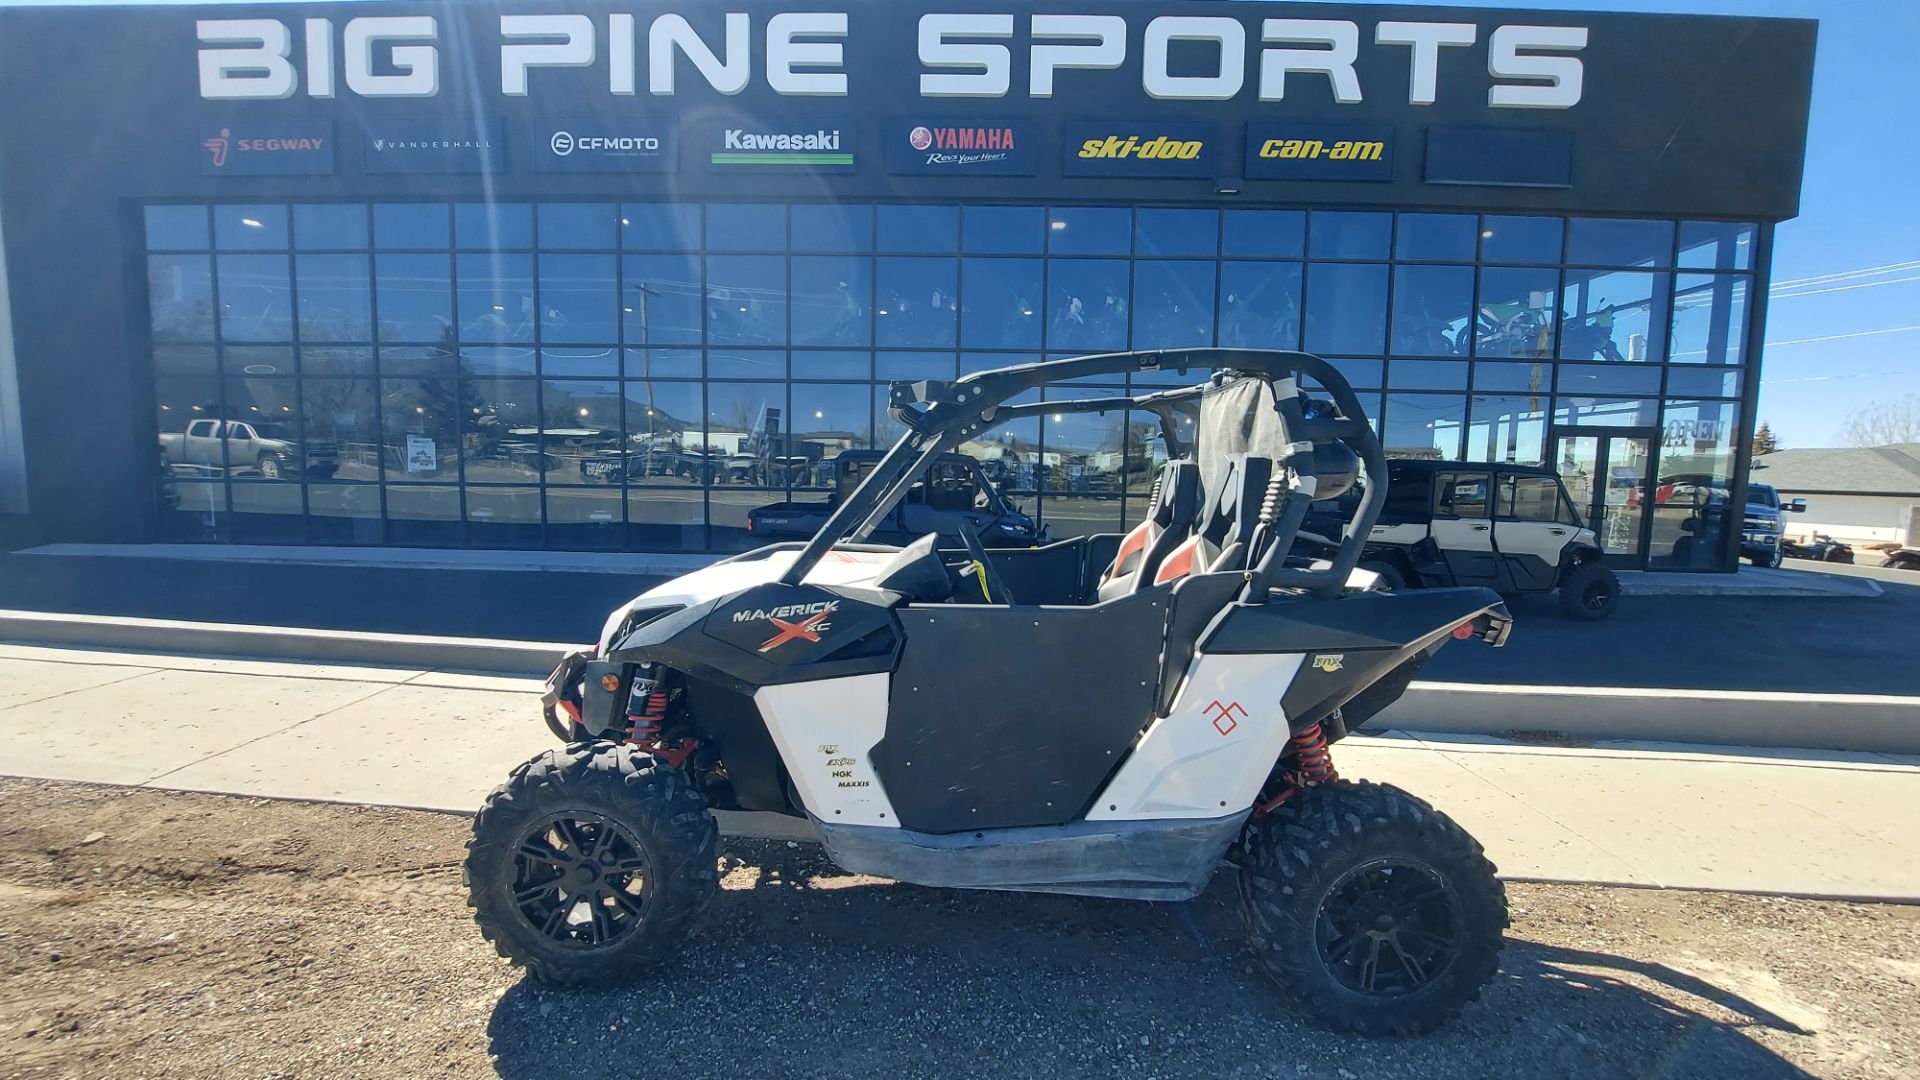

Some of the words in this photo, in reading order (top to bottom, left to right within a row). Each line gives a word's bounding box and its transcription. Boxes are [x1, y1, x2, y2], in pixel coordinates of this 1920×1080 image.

[197, 16, 439, 98] BIG
[501, 12, 849, 96] PINE
[918, 14, 1589, 108] SPORTS
[238, 138, 323, 151] SEGWAY
[388, 141, 492, 149] VANDERHALL
[578, 137, 659, 150] CFMOTO
[725, 130, 840, 150] Kawasaki
[933, 128, 1014, 149] YAMAHA
[1078, 135, 1203, 159] ski-doo
[926, 153, 958, 164] Revs
[958, 153, 981, 164] Your
[1667, 419, 1727, 441] OPEN
[733, 600, 840, 623] MAVERICK
[832, 770, 852, 778] NGK
